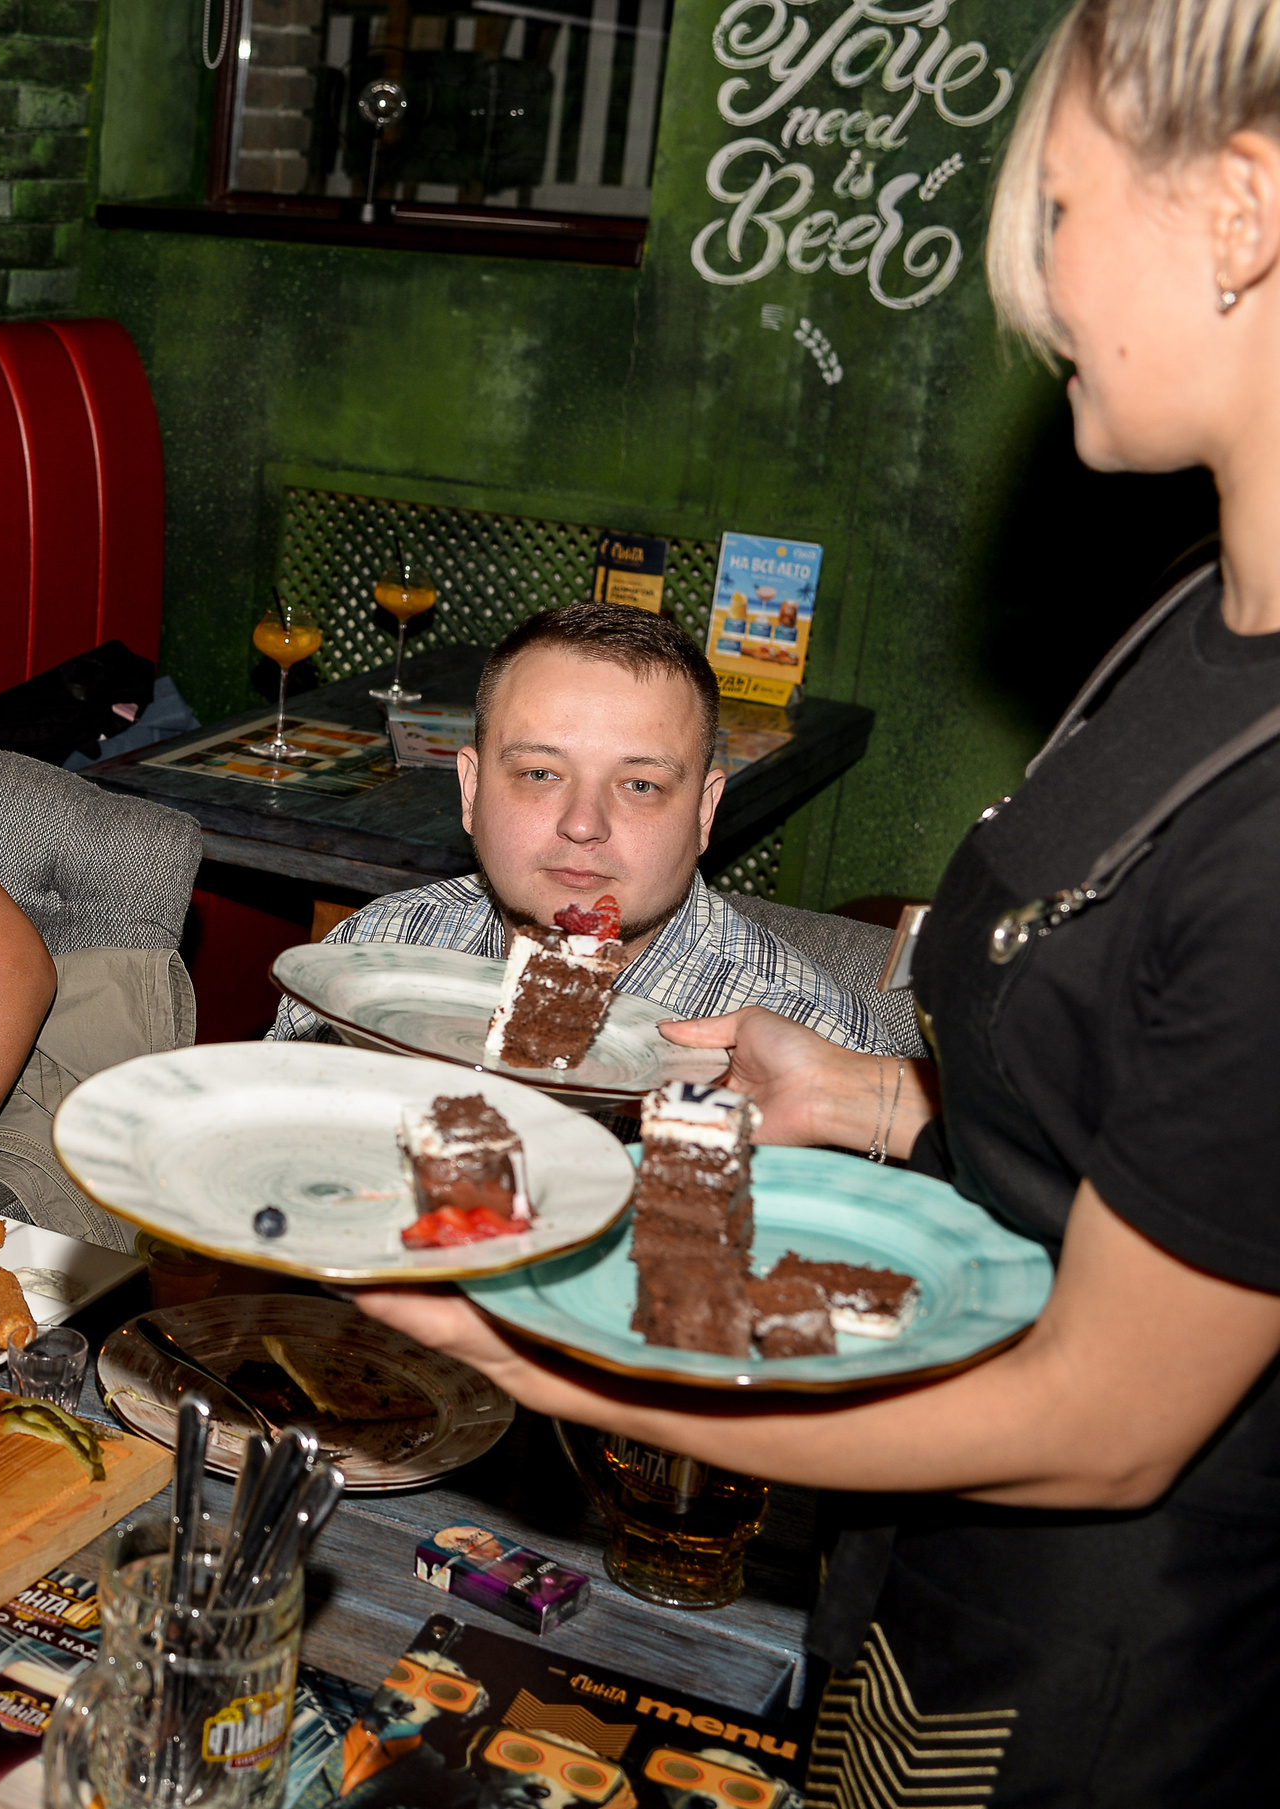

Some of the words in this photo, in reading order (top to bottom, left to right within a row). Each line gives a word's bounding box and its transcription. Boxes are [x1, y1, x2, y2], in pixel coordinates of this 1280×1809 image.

[780, 88, 920, 151] need
[832, 149, 875, 199] is
[690, 137, 963, 310] Beer
[729, 555, 750, 570] НА
[751, 557, 774, 574] ВСЕ
[776, 562, 812, 580] ЛЕТО
[13, 1619, 55, 1641] КАК
[636, 1696, 798, 1761] menu
